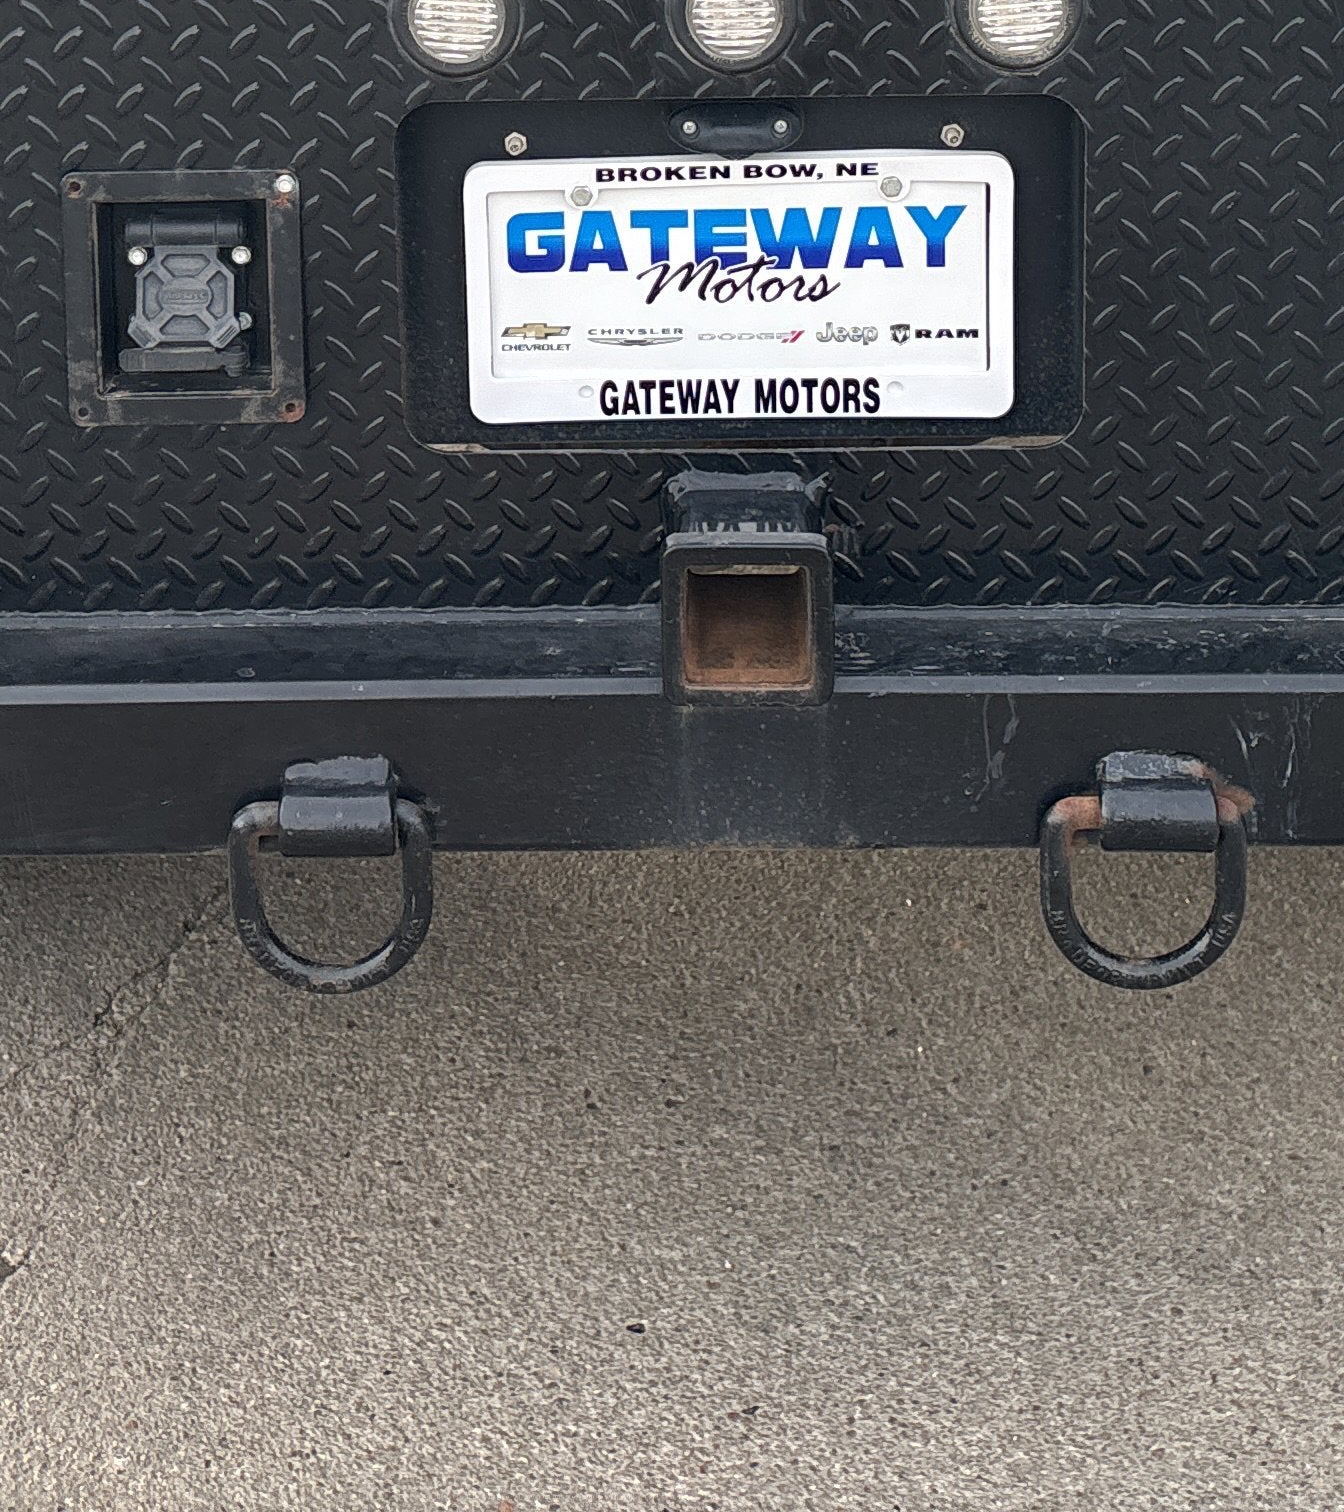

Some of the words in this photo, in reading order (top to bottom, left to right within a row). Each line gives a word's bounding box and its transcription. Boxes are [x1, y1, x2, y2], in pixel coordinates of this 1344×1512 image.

[595, 166, 731, 183] BROKEN
[742, 163, 825, 180] BOW,
[835, 162, 879, 177] NE
[506, 204, 967, 273] GATEWAY
[635, 255, 842, 305] Motors
[587, 327, 684, 336] CHRYSLER
[697, 332, 796, 342] DODGE
[815, 321, 879, 346] Jeep
[914, 327, 980, 339] RAM
[501, 343, 572, 352] CHEVROLET
[599, 380, 739, 416] GATEWAY
[754, 377, 881, 413] MOTORS
